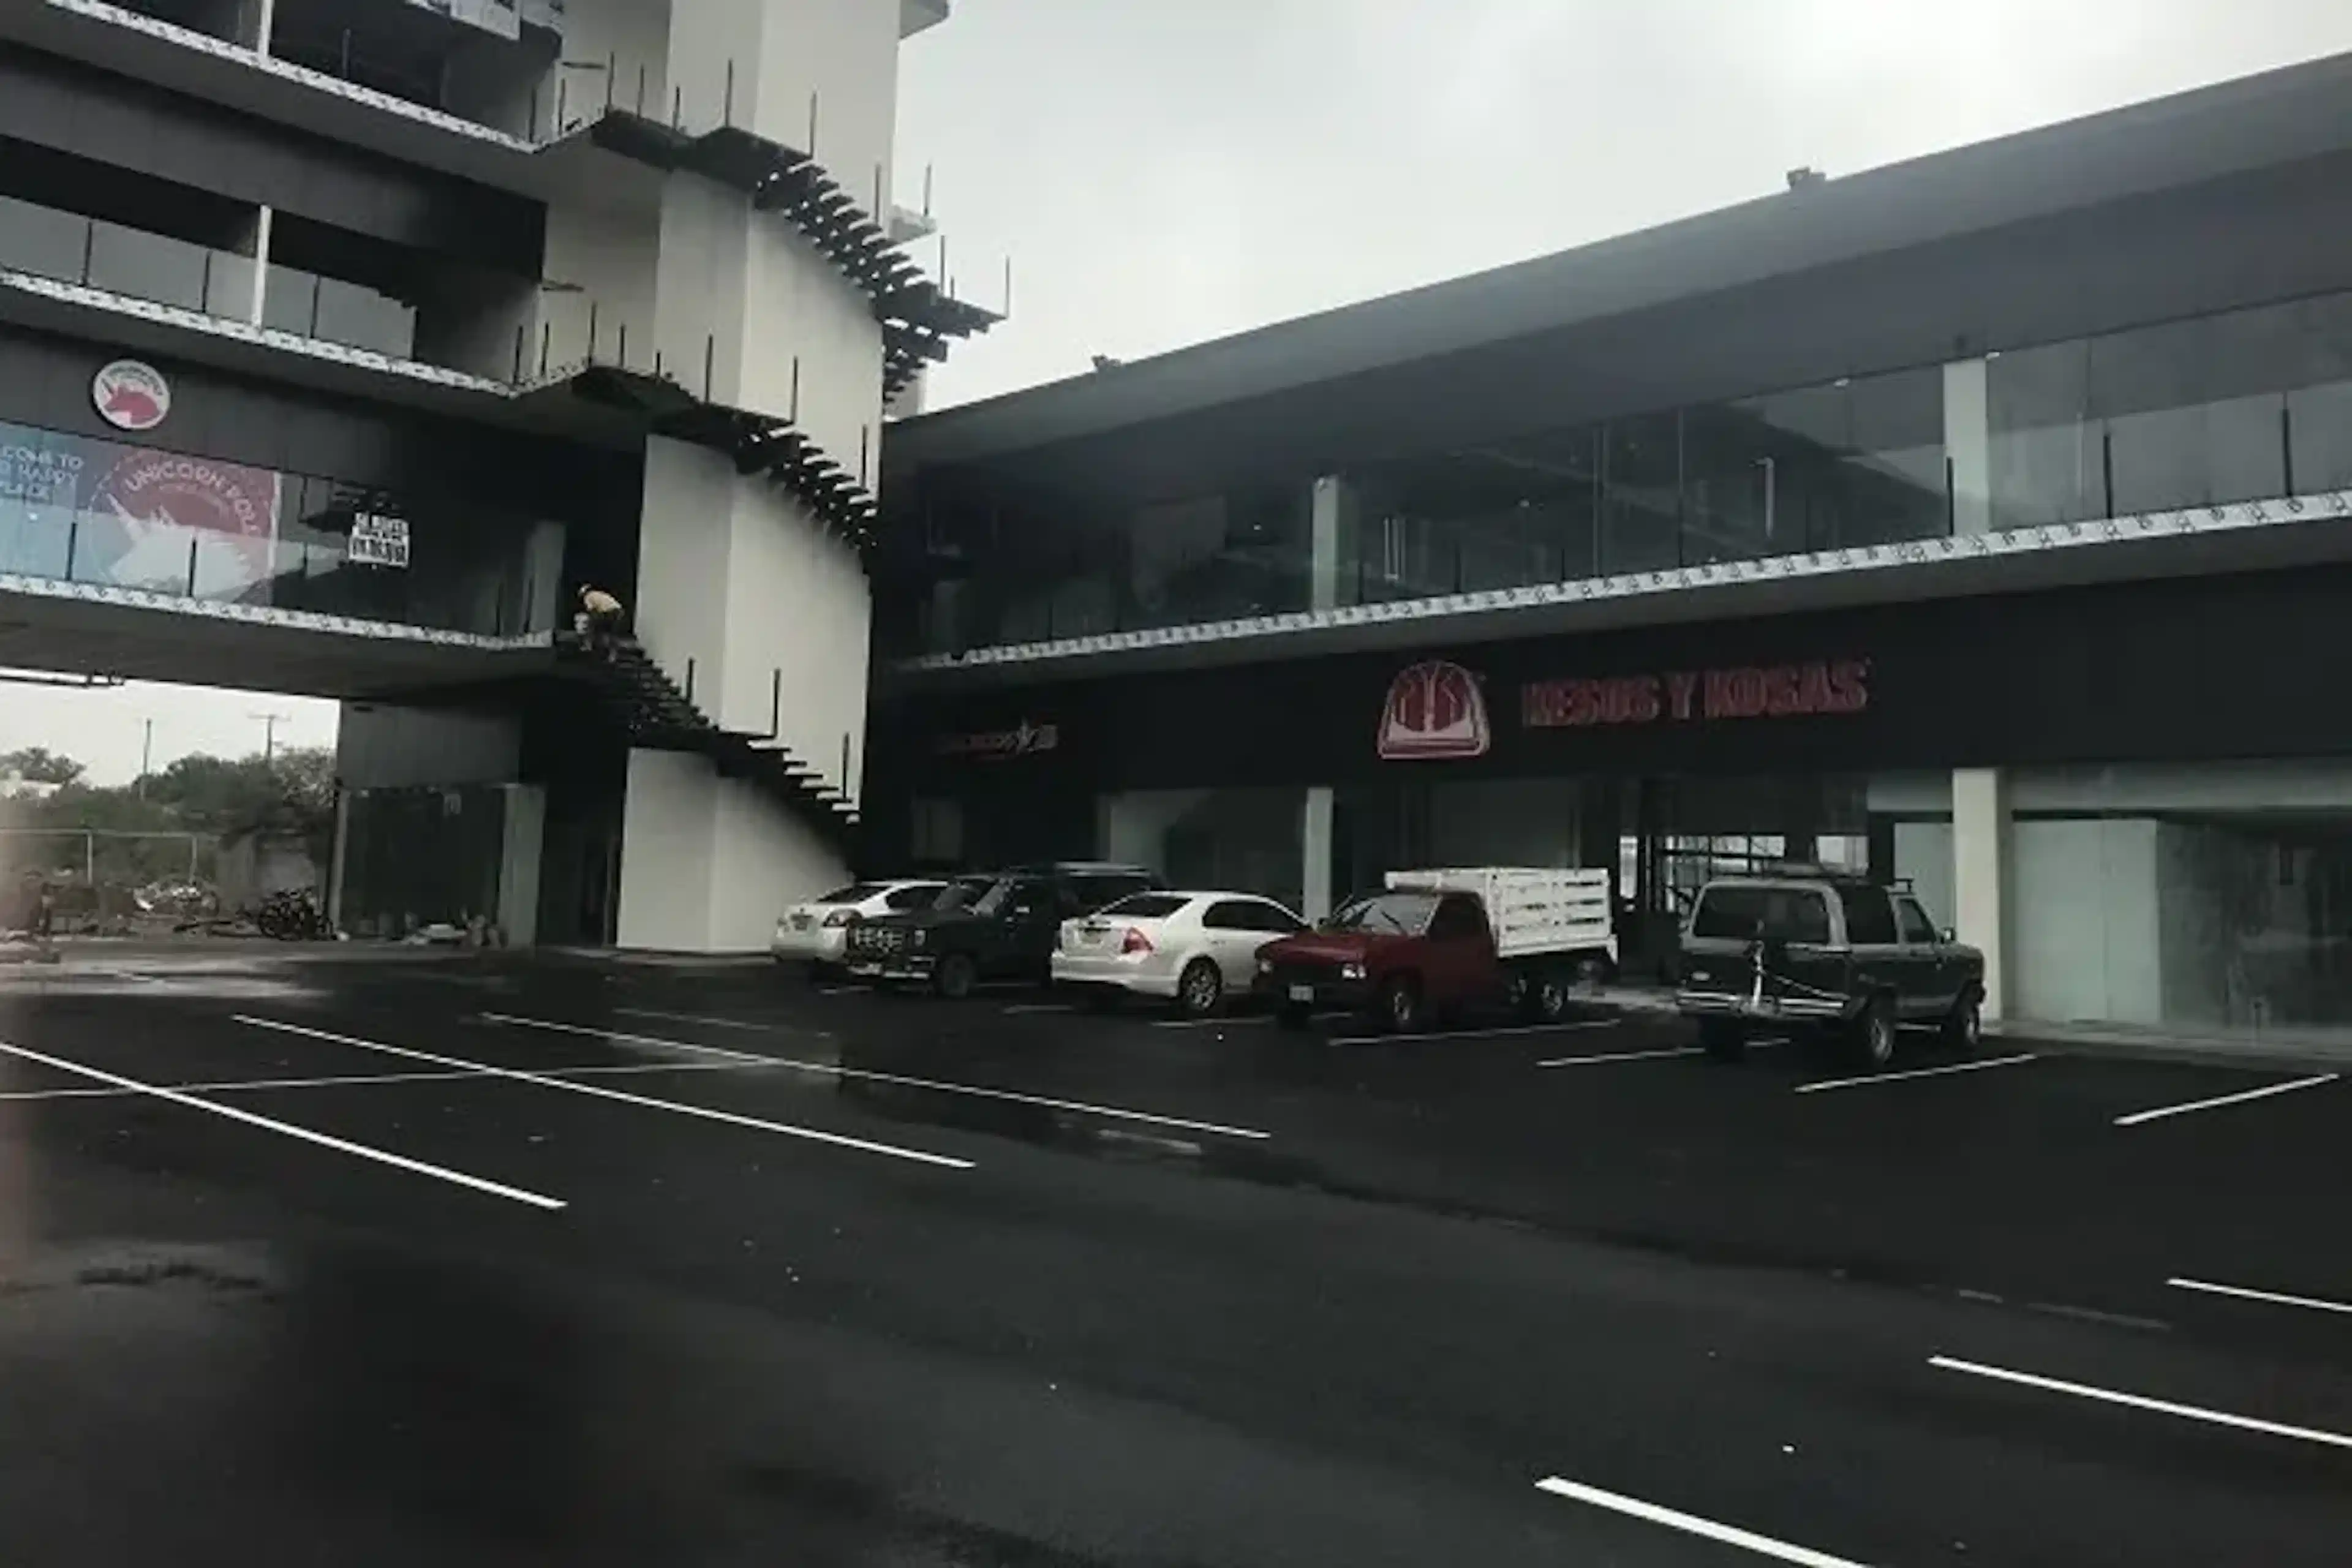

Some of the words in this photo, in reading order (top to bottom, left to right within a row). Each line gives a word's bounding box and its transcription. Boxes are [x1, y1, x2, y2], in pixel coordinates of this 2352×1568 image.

[124, 461, 227, 491] UNICORN
[1667, 671, 1697, 720] Y
[1704, 661, 1868, 718] KOSAS
